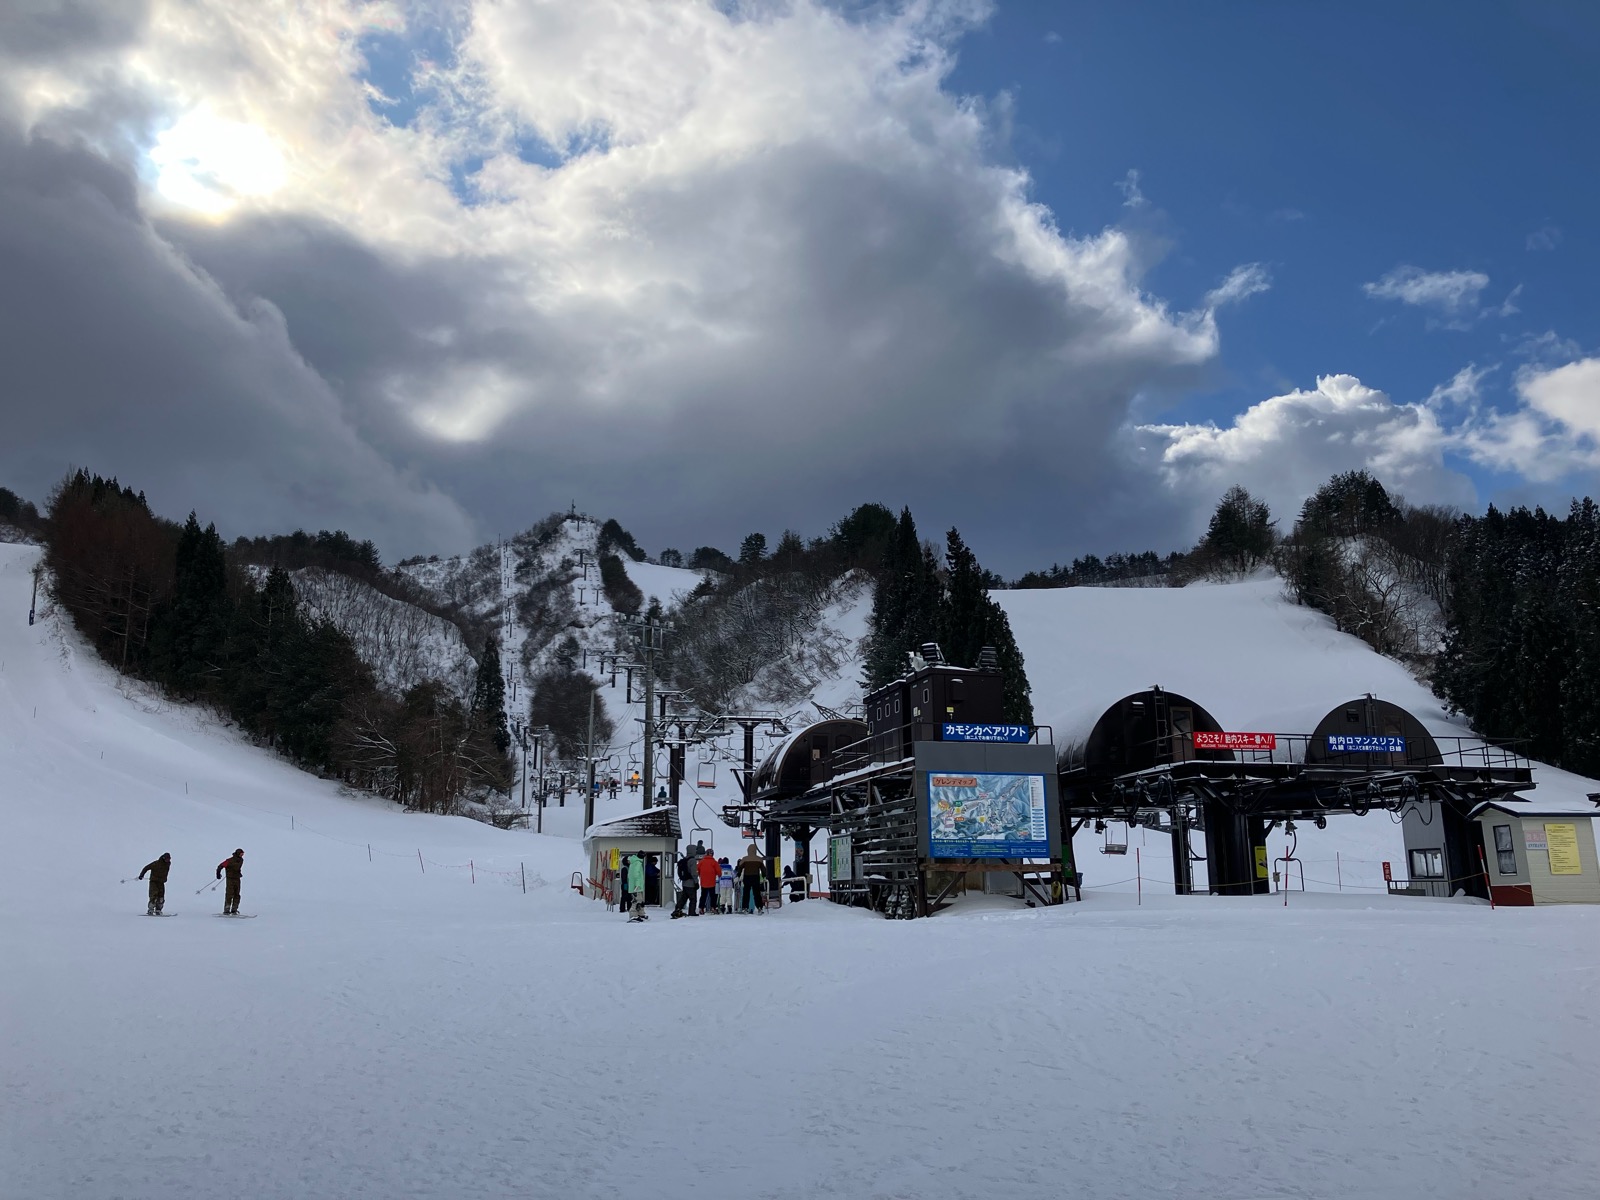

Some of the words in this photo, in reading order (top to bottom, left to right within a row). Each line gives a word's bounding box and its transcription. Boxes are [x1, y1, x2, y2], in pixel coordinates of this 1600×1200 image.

[945, 725, 1026, 736] カモシカペアリフト
[1329, 736, 1403, 746] 胎内ロマンスリフト
